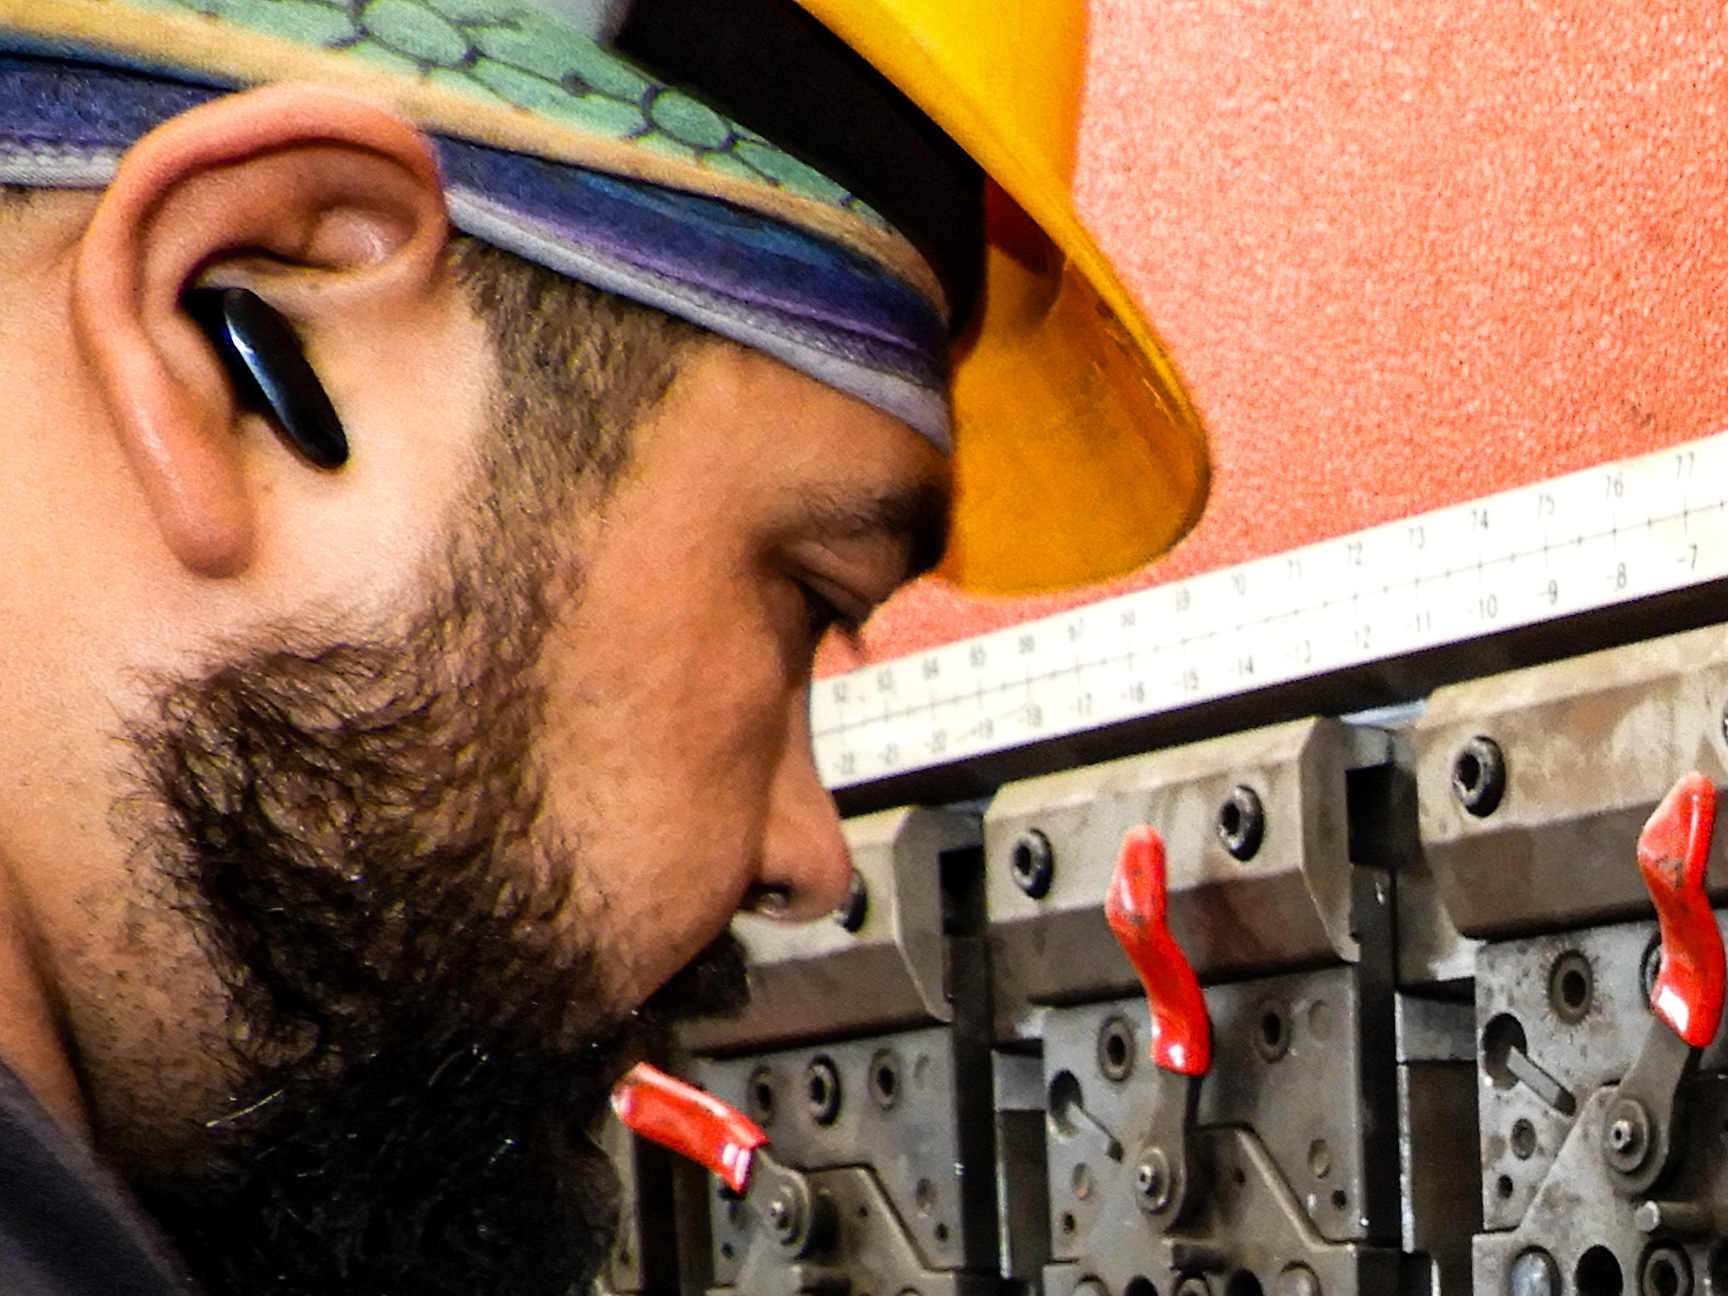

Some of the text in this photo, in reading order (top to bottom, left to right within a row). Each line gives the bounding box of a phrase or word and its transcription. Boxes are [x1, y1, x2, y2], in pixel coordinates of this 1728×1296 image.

[1347, 541, 1363, 565] 72
[1408, 525, 1425, 549] 73
[1471, 507, 1489, 533] 74
[1538, 492, 1555, 517] 75
[1606, 471, 1624, 498] 76
[1675, 452, 1694, 480] 77
[1606, 562, 1627, 589] -8
[1676, 544, 1697, 569] -7
